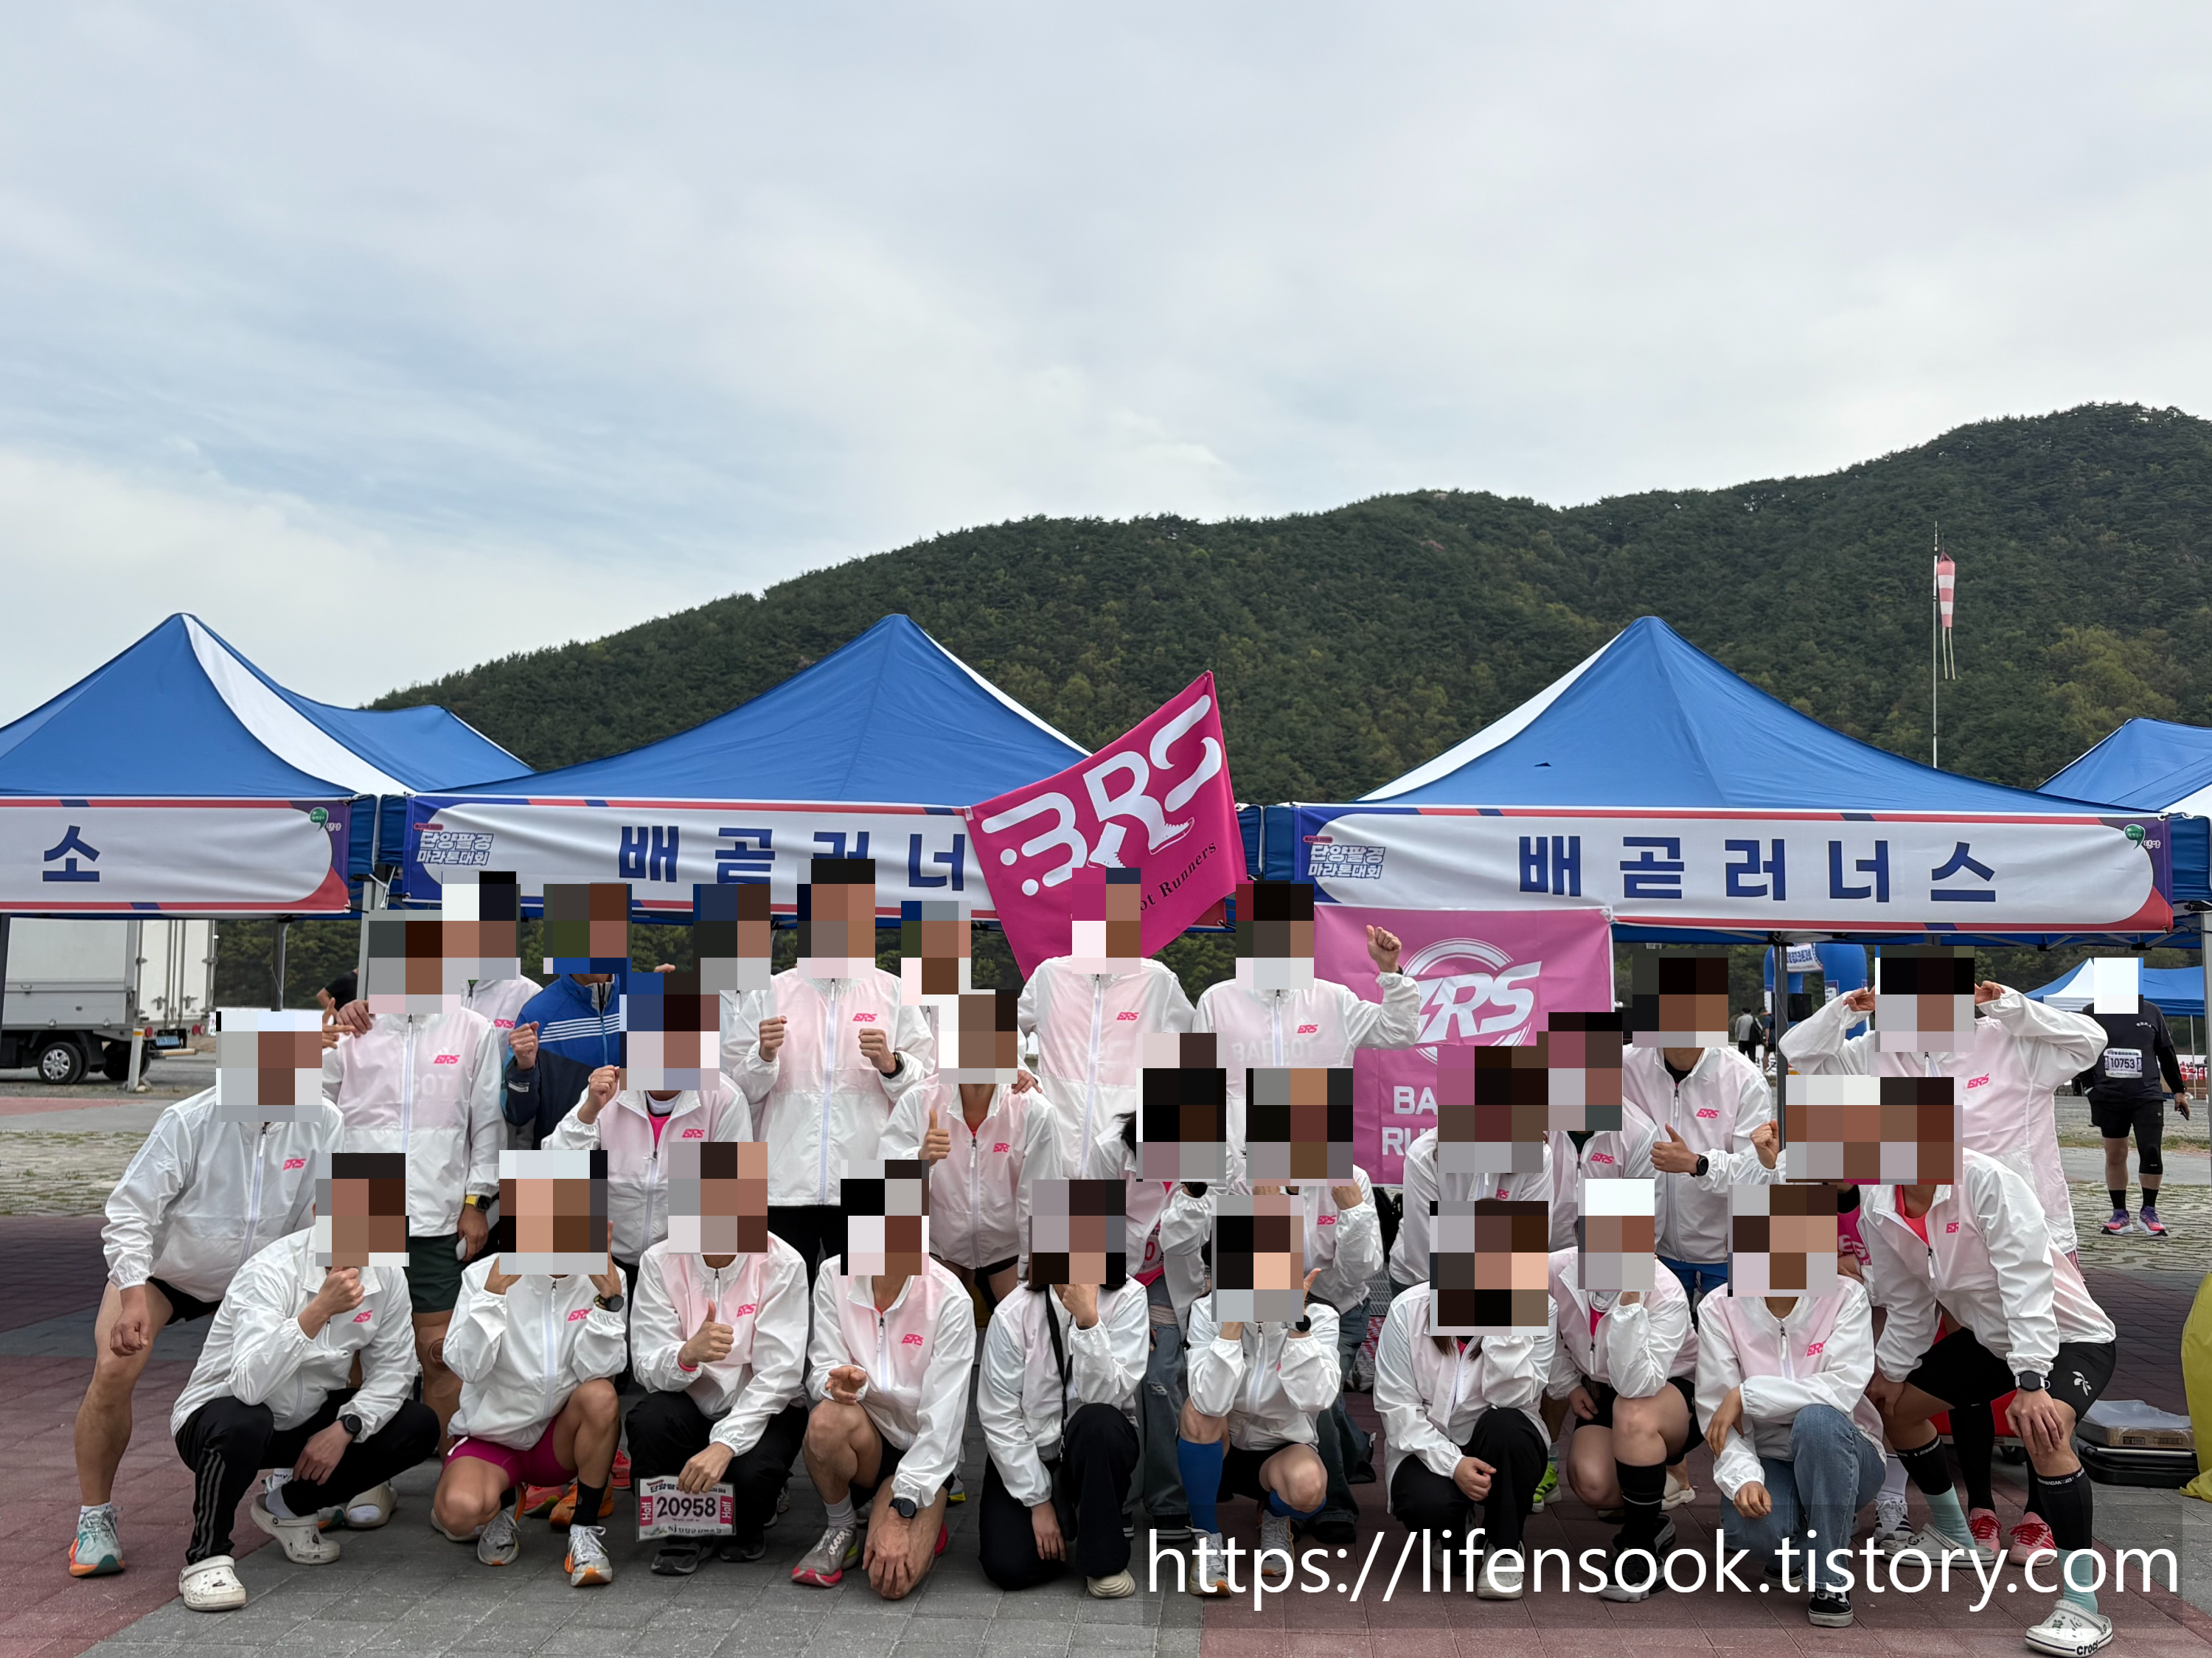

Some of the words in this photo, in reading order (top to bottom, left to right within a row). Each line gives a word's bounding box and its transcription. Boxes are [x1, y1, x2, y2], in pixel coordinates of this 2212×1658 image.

[420, 832, 493, 851] 단양팔경
[43, 825, 100, 882] 소
[417, 851, 490, 866] 마라톤대회
[1310, 844, 1385, 864] 단양팔경
[1158, 842, 1216, 897] Runners
[1308, 863, 1382, 879] 마라톤대회
[2110, 1058, 2135, 1069] 10753
[641, 1502, 652, 1521] Half
[656, 1497, 716, 1518] 20958
